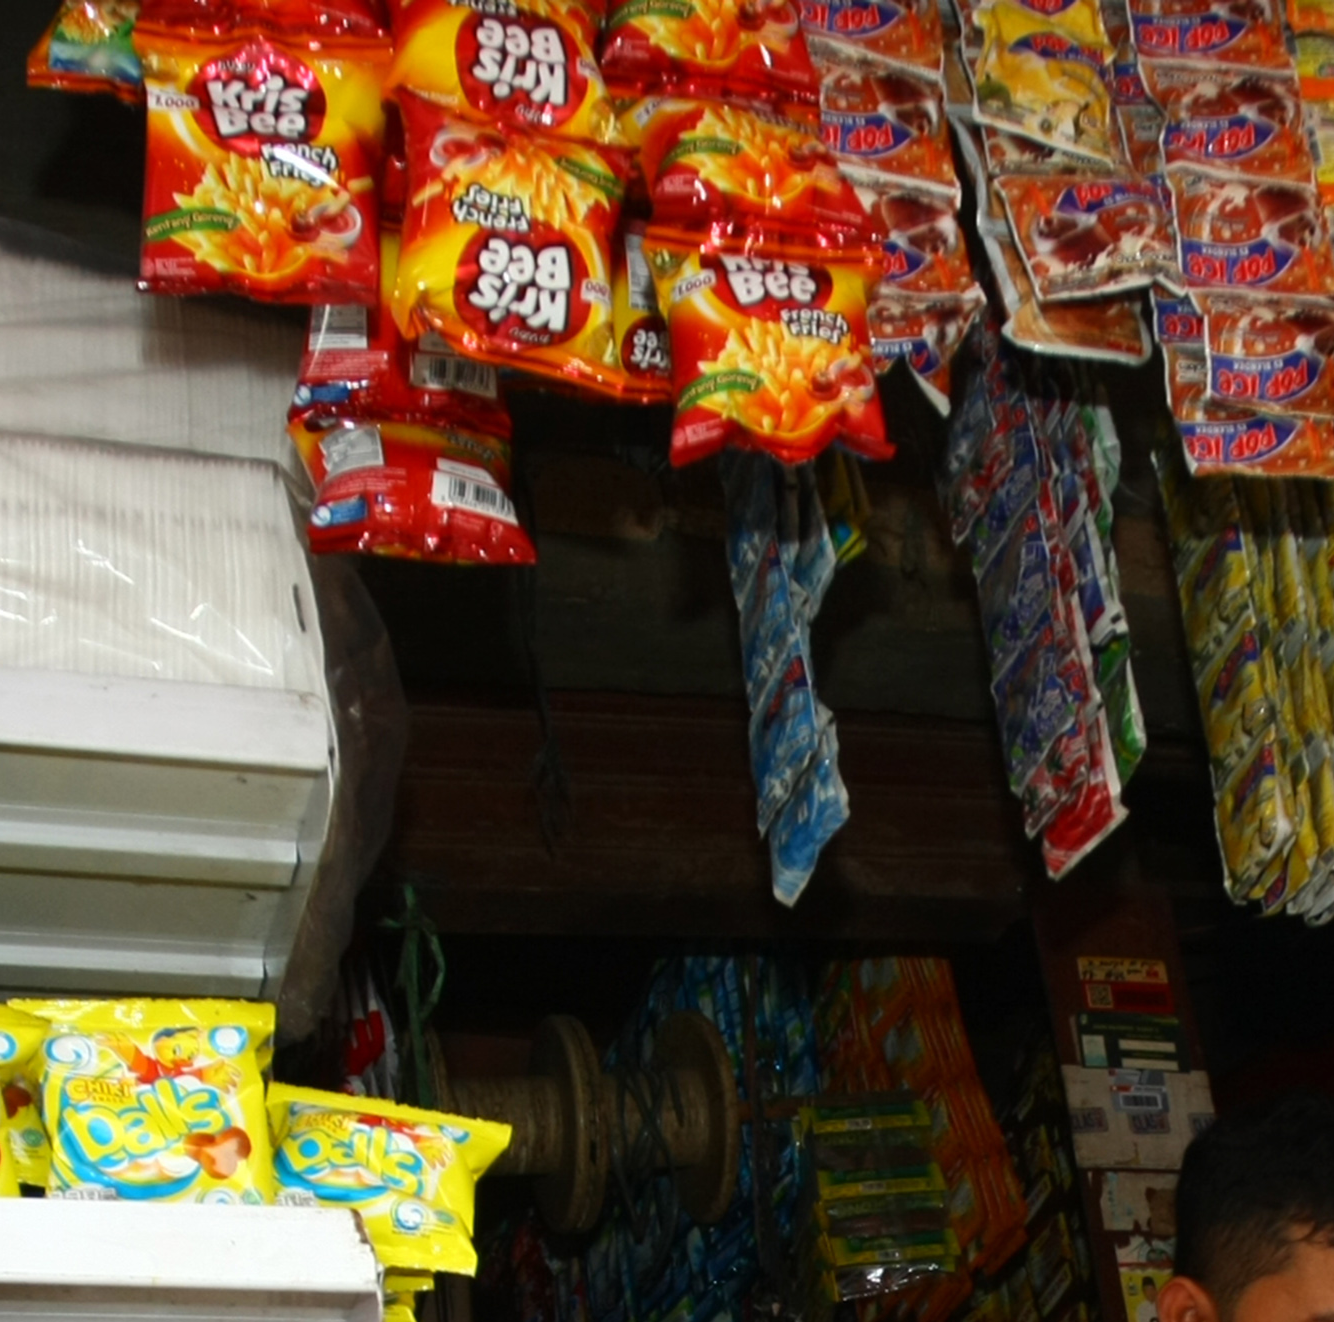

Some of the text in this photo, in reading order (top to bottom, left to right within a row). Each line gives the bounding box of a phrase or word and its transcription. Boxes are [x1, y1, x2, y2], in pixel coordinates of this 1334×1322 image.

[834, 5, 880, 28] POP
[476, 18, 566, 64] Bee
[1137, 20, 1229, 53] POP ICE
[205, 75, 310, 114] Kris
[471, 47, 567, 107] Kris
[211, 104, 306, 138] Bee
[848, 124, 894, 150] POP
[1212, 122, 1255, 155] POP
[451, 198, 531, 234] French
[461, 183, 523, 217] Fries
[478, 237, 571, 291] Bee
[1188, 248, 1276, 283] POP ICE
[468, 271, 568, 334] Kris
[728, 272, 817, 307] Bee
[780, 306, 849, 333] French
[790, 320, 843, 345] Fries
[1216, 360, 1309, 401] POP ICE
[1231, 423, 1276, 460] POP
[65, 1073, 135, 1099] CHIKI
[62, 1073, 231, 1163] balls
[279, 1125, 425, 1196] balls
